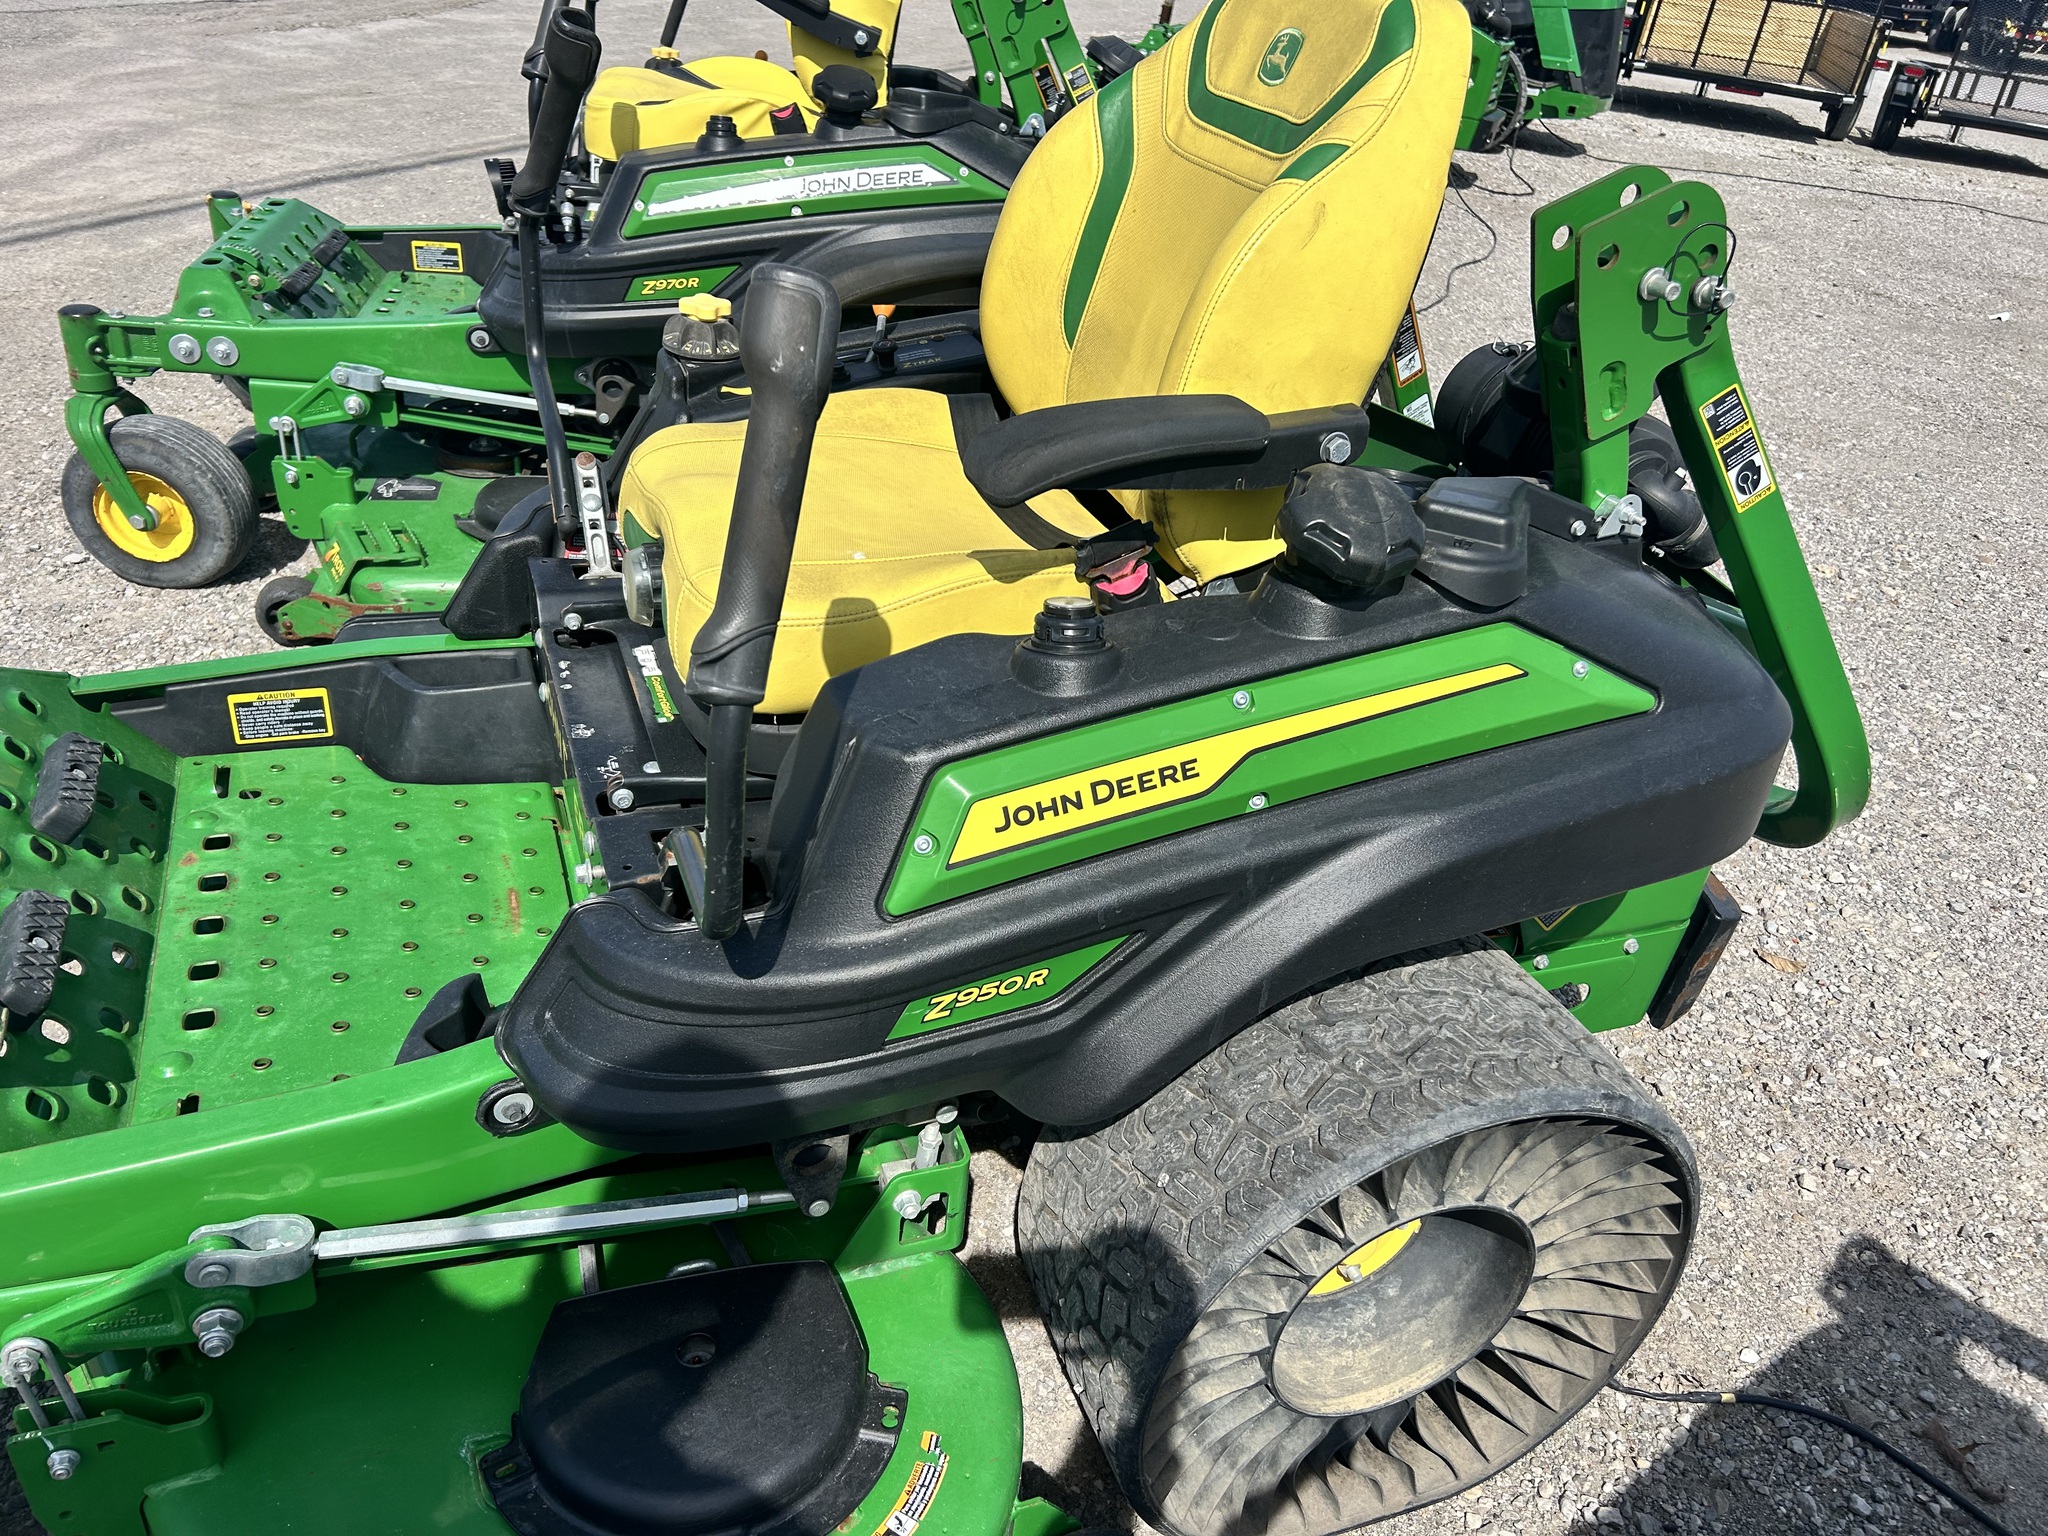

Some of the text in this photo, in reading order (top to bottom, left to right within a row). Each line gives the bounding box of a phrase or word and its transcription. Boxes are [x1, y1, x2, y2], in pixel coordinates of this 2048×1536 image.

[801, 170, 923, 193] JOHN DEERE
[641, 277, 700, 295] Z970R
[1740, 488, 1768, 510] CAUTION
[995, 758, 1200, 833] JOHN DEERE
[920, 968, 1050, 1023] Z950R
